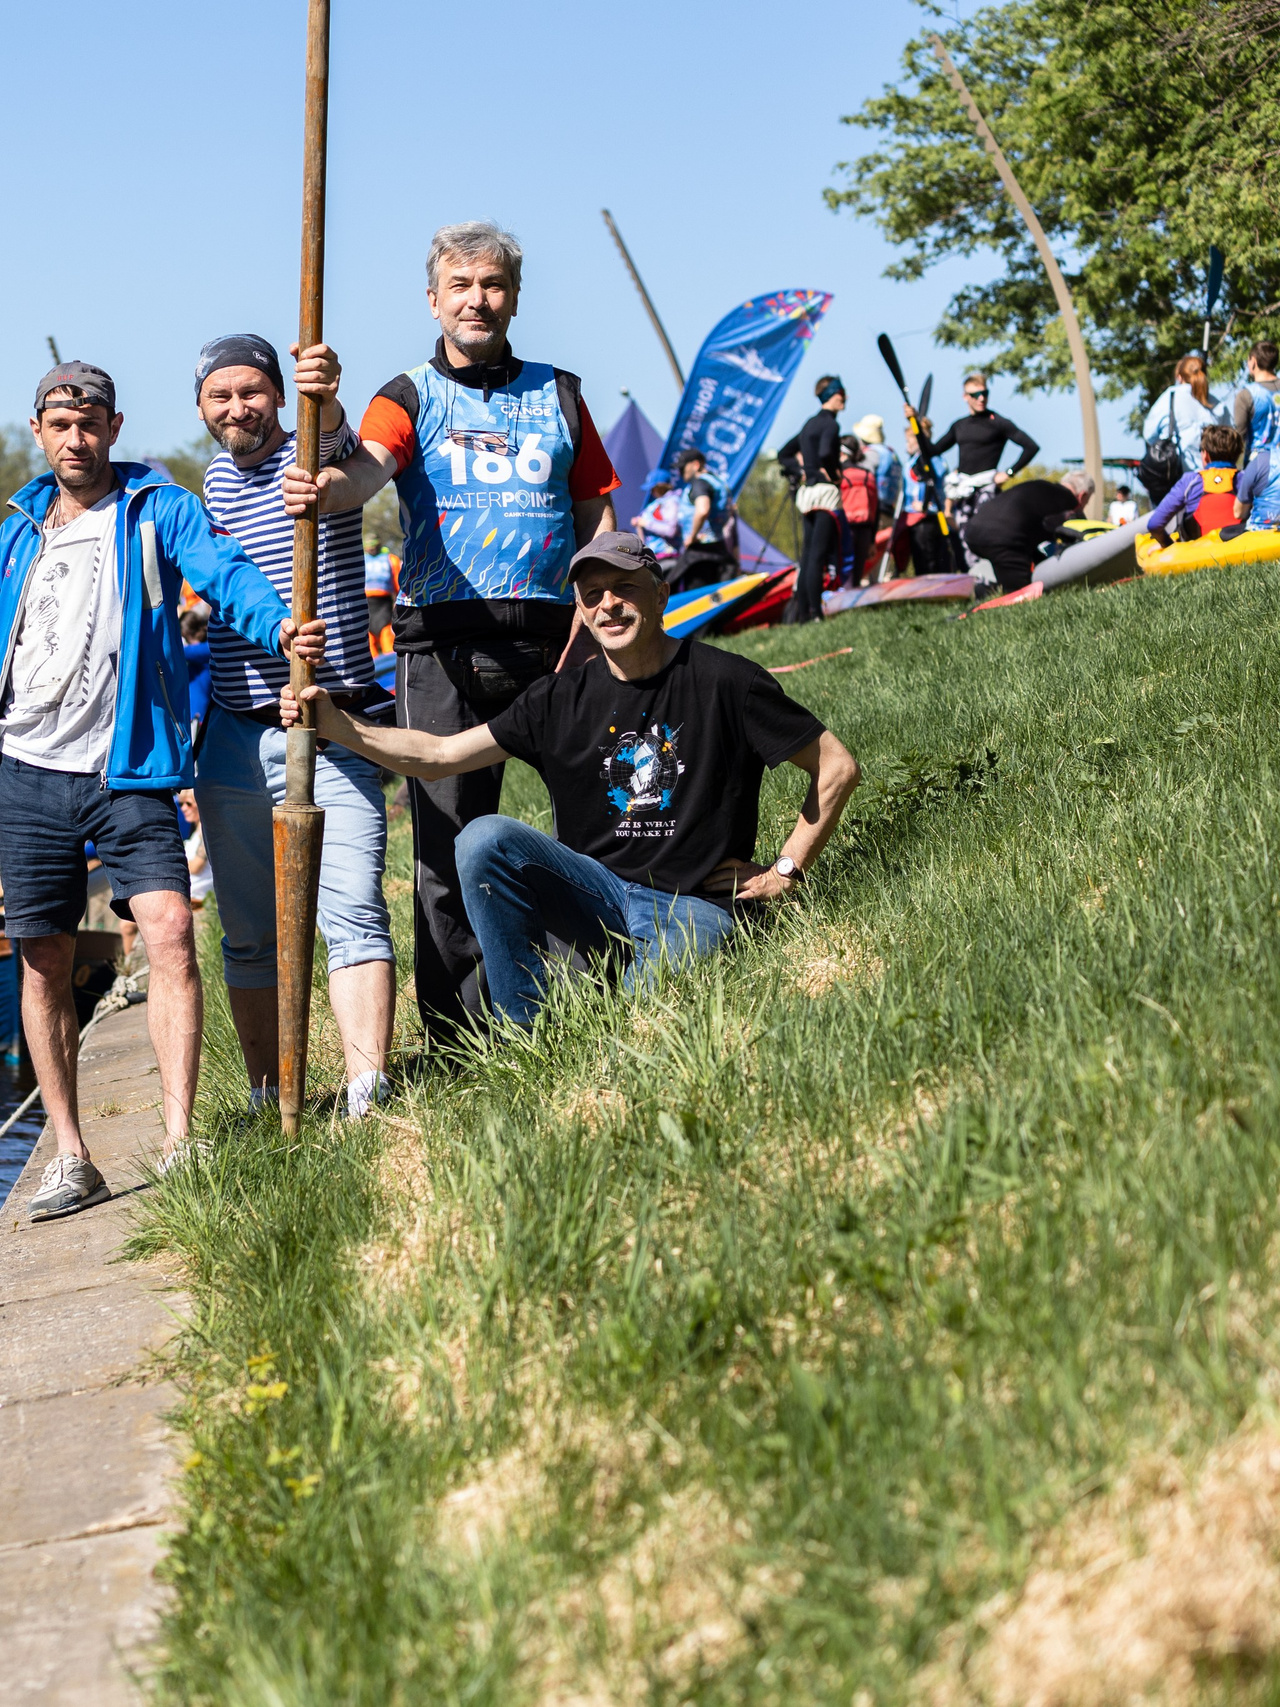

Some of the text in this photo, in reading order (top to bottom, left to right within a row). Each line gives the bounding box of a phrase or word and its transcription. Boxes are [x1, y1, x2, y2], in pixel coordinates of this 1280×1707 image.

[500, 405, 553, 418] CANOE
[436, 433, 552, 486] 186
[632, 821, 641, 829] IS
[644, 820, 676, 828] WHAT
